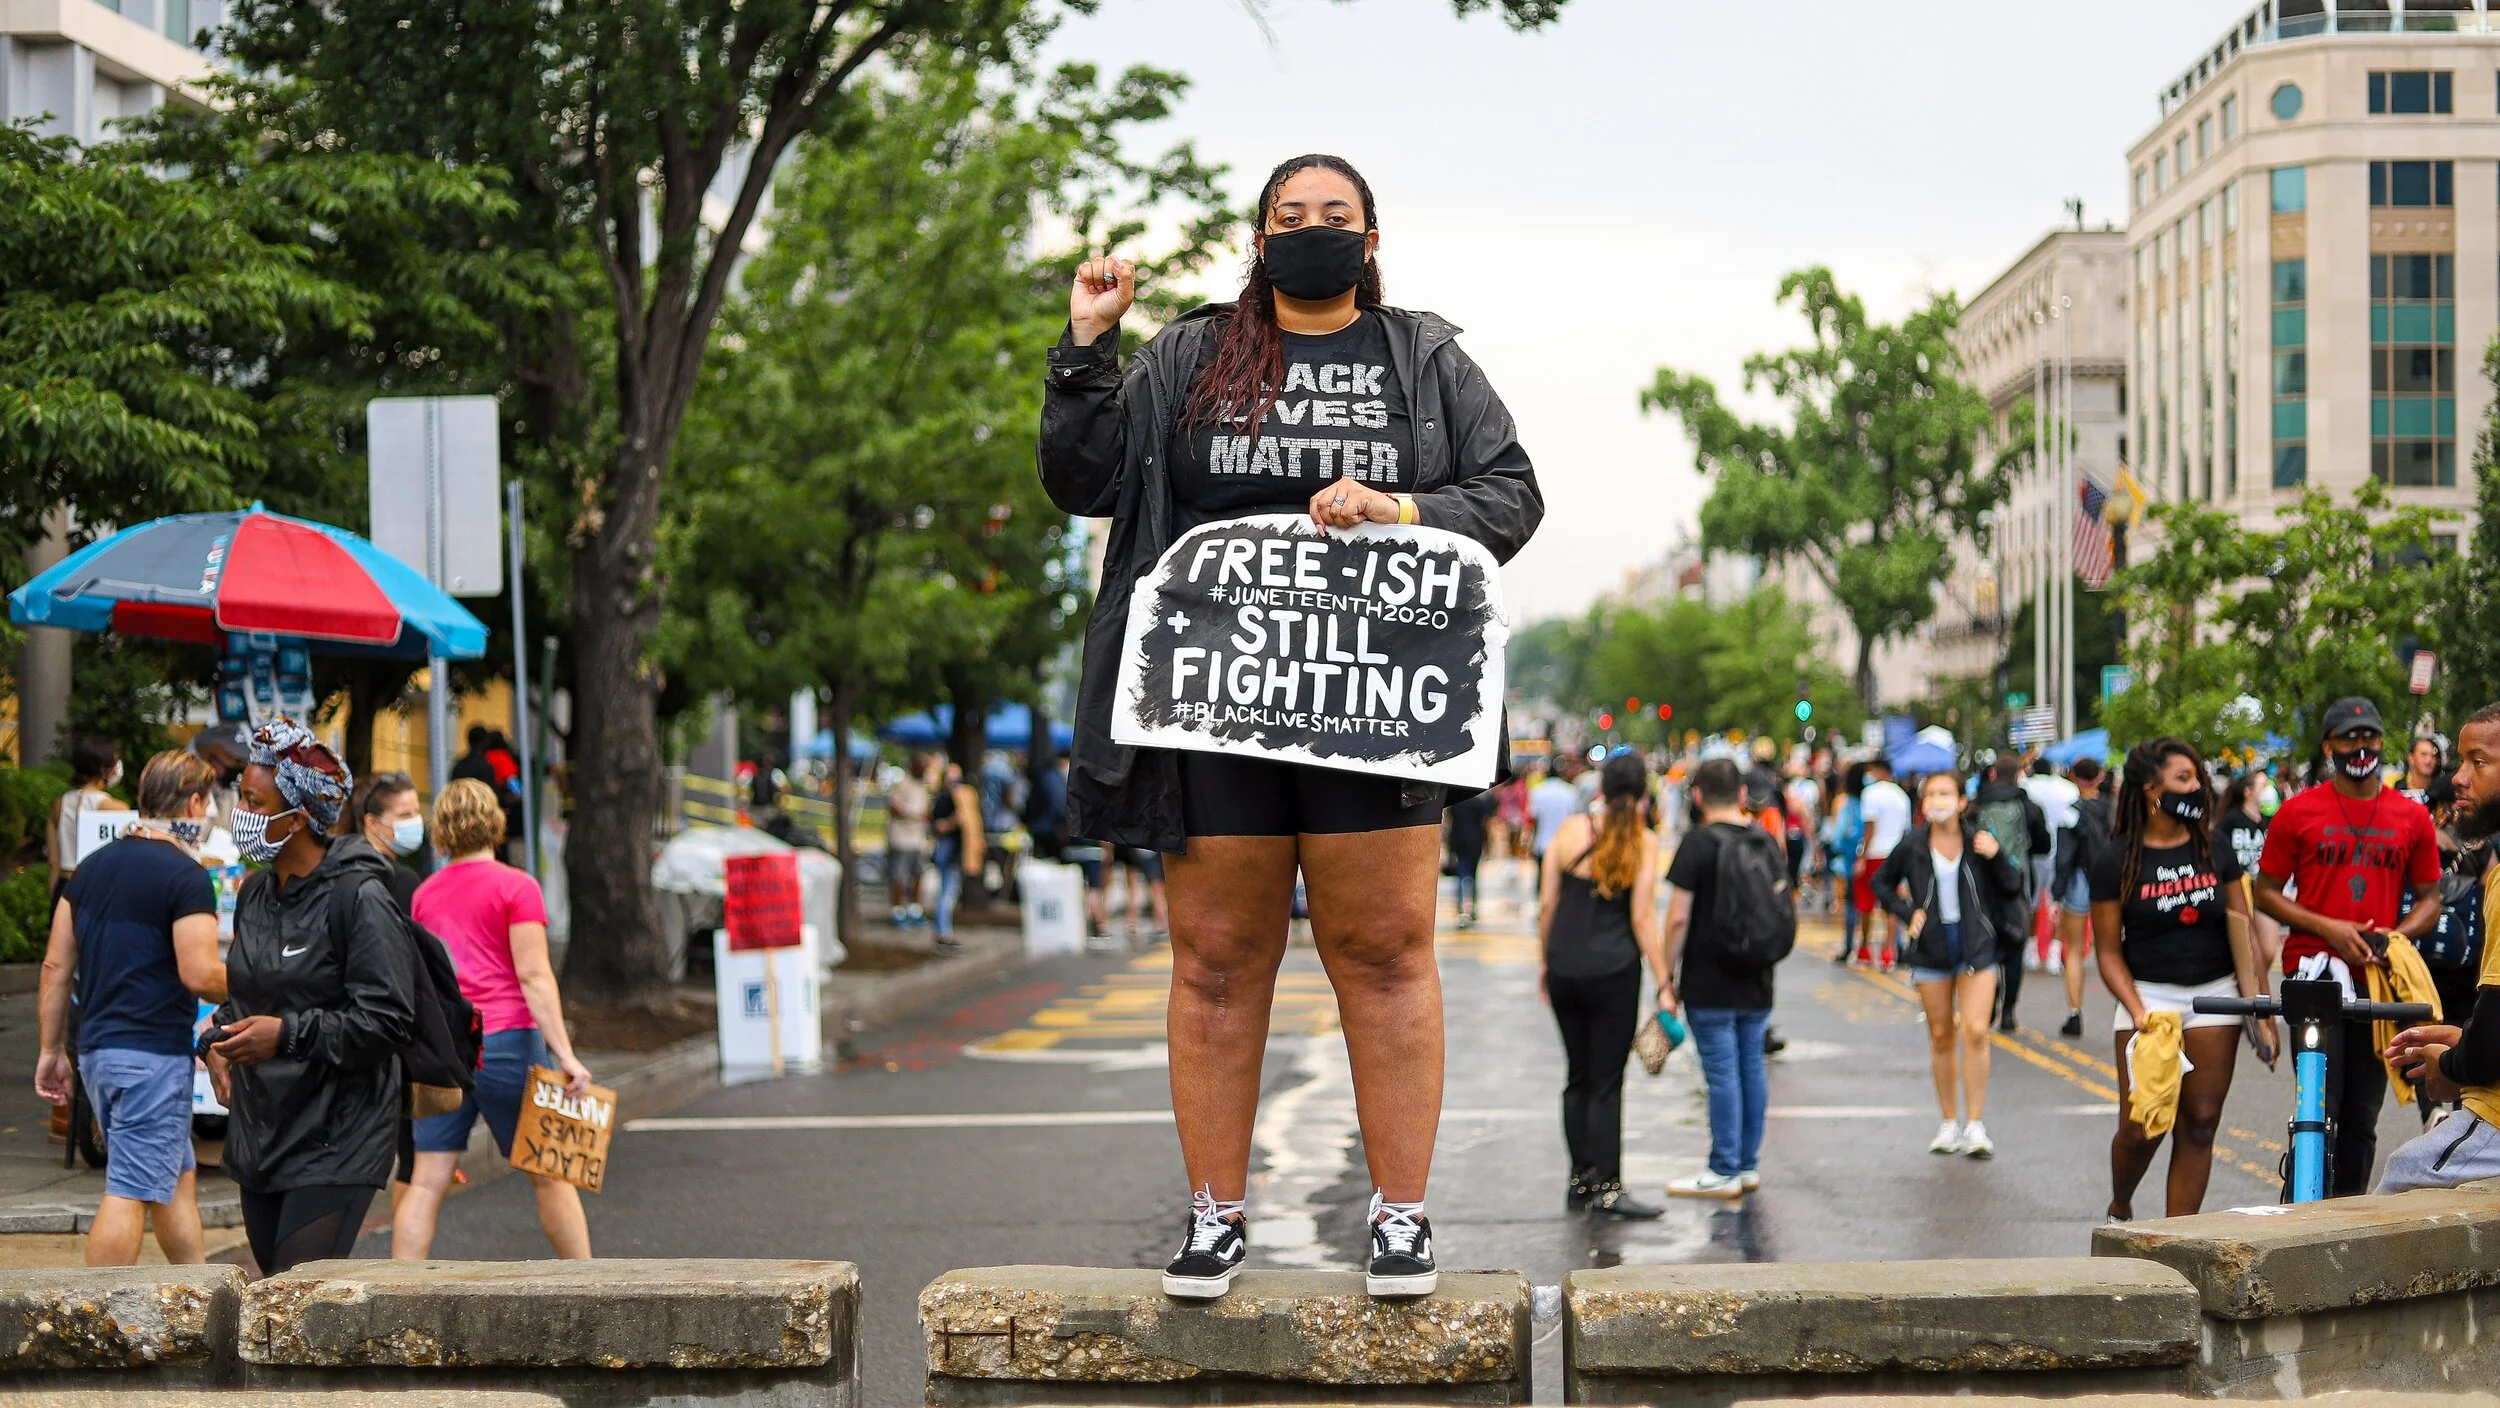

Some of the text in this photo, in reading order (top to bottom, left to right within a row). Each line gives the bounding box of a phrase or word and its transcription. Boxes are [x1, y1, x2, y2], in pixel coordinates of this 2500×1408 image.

[1228, 363, 1386, 396] ACK
[1209, 435, 1399, 482] MATTER
[1207, 584, 1449, 630] #JUNETEENTH2020
[1230, 605, 1389, 665] STILL
[1171, 646, 1450, 724] FIGHTING
[1171, 700, 1409, 737] #BLACKLIVESMATTER
[2231, 827, 2269, 851] BLA
[533, 1081, 611, 1129] MATTER
[540, 1115, 596, 1152] LIVES
[522, 1136, 602, 1188] BLACK
